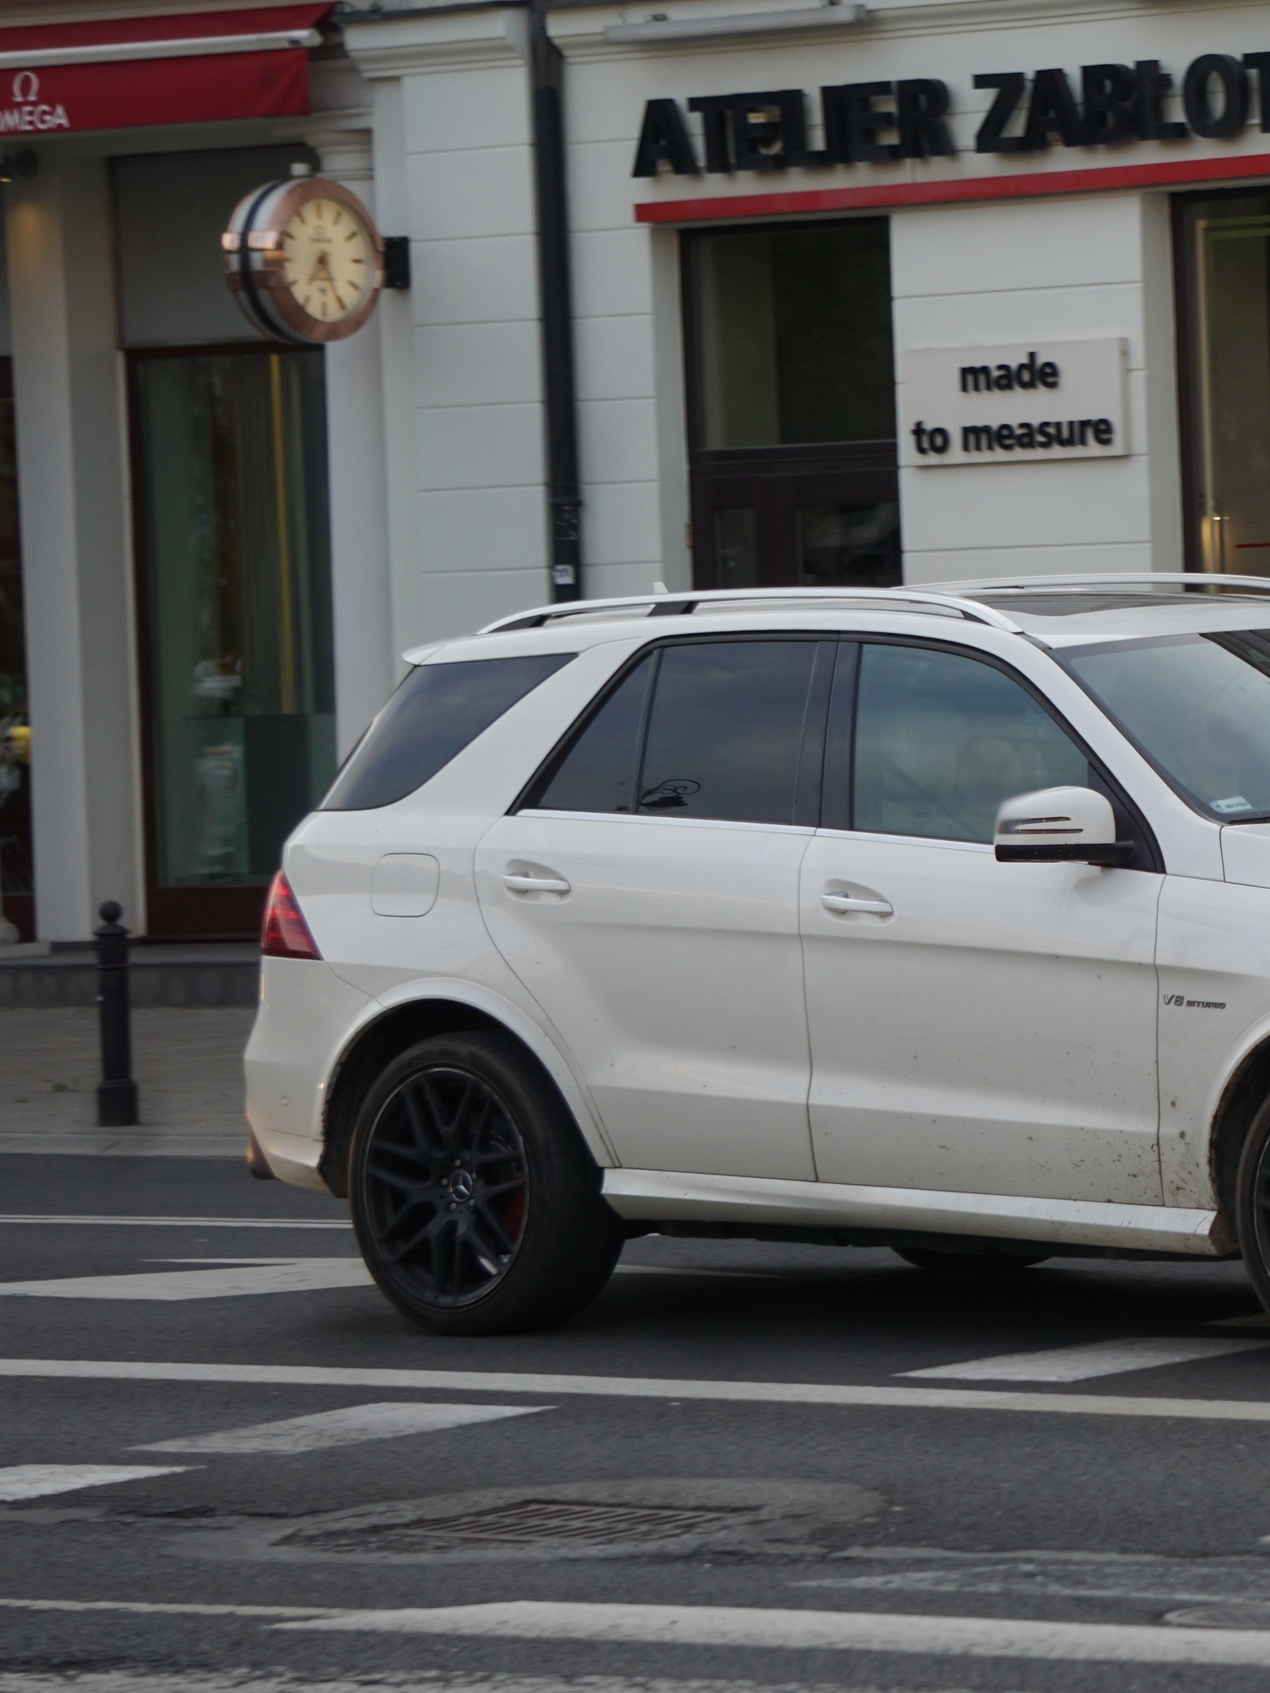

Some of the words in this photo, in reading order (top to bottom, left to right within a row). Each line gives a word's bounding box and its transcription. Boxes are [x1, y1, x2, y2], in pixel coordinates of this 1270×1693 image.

[0, 104, 70, 132] MEGA
[631, 78, 957, 178] ATELIER
[959, 351, 1060, 393] made
[911, 420, 950, 455] to
[961, 417, 1114, 452] measure
[1163, 993, 1185, 1007] V8
[1186, 999, 1227, 1010] BITURBO
